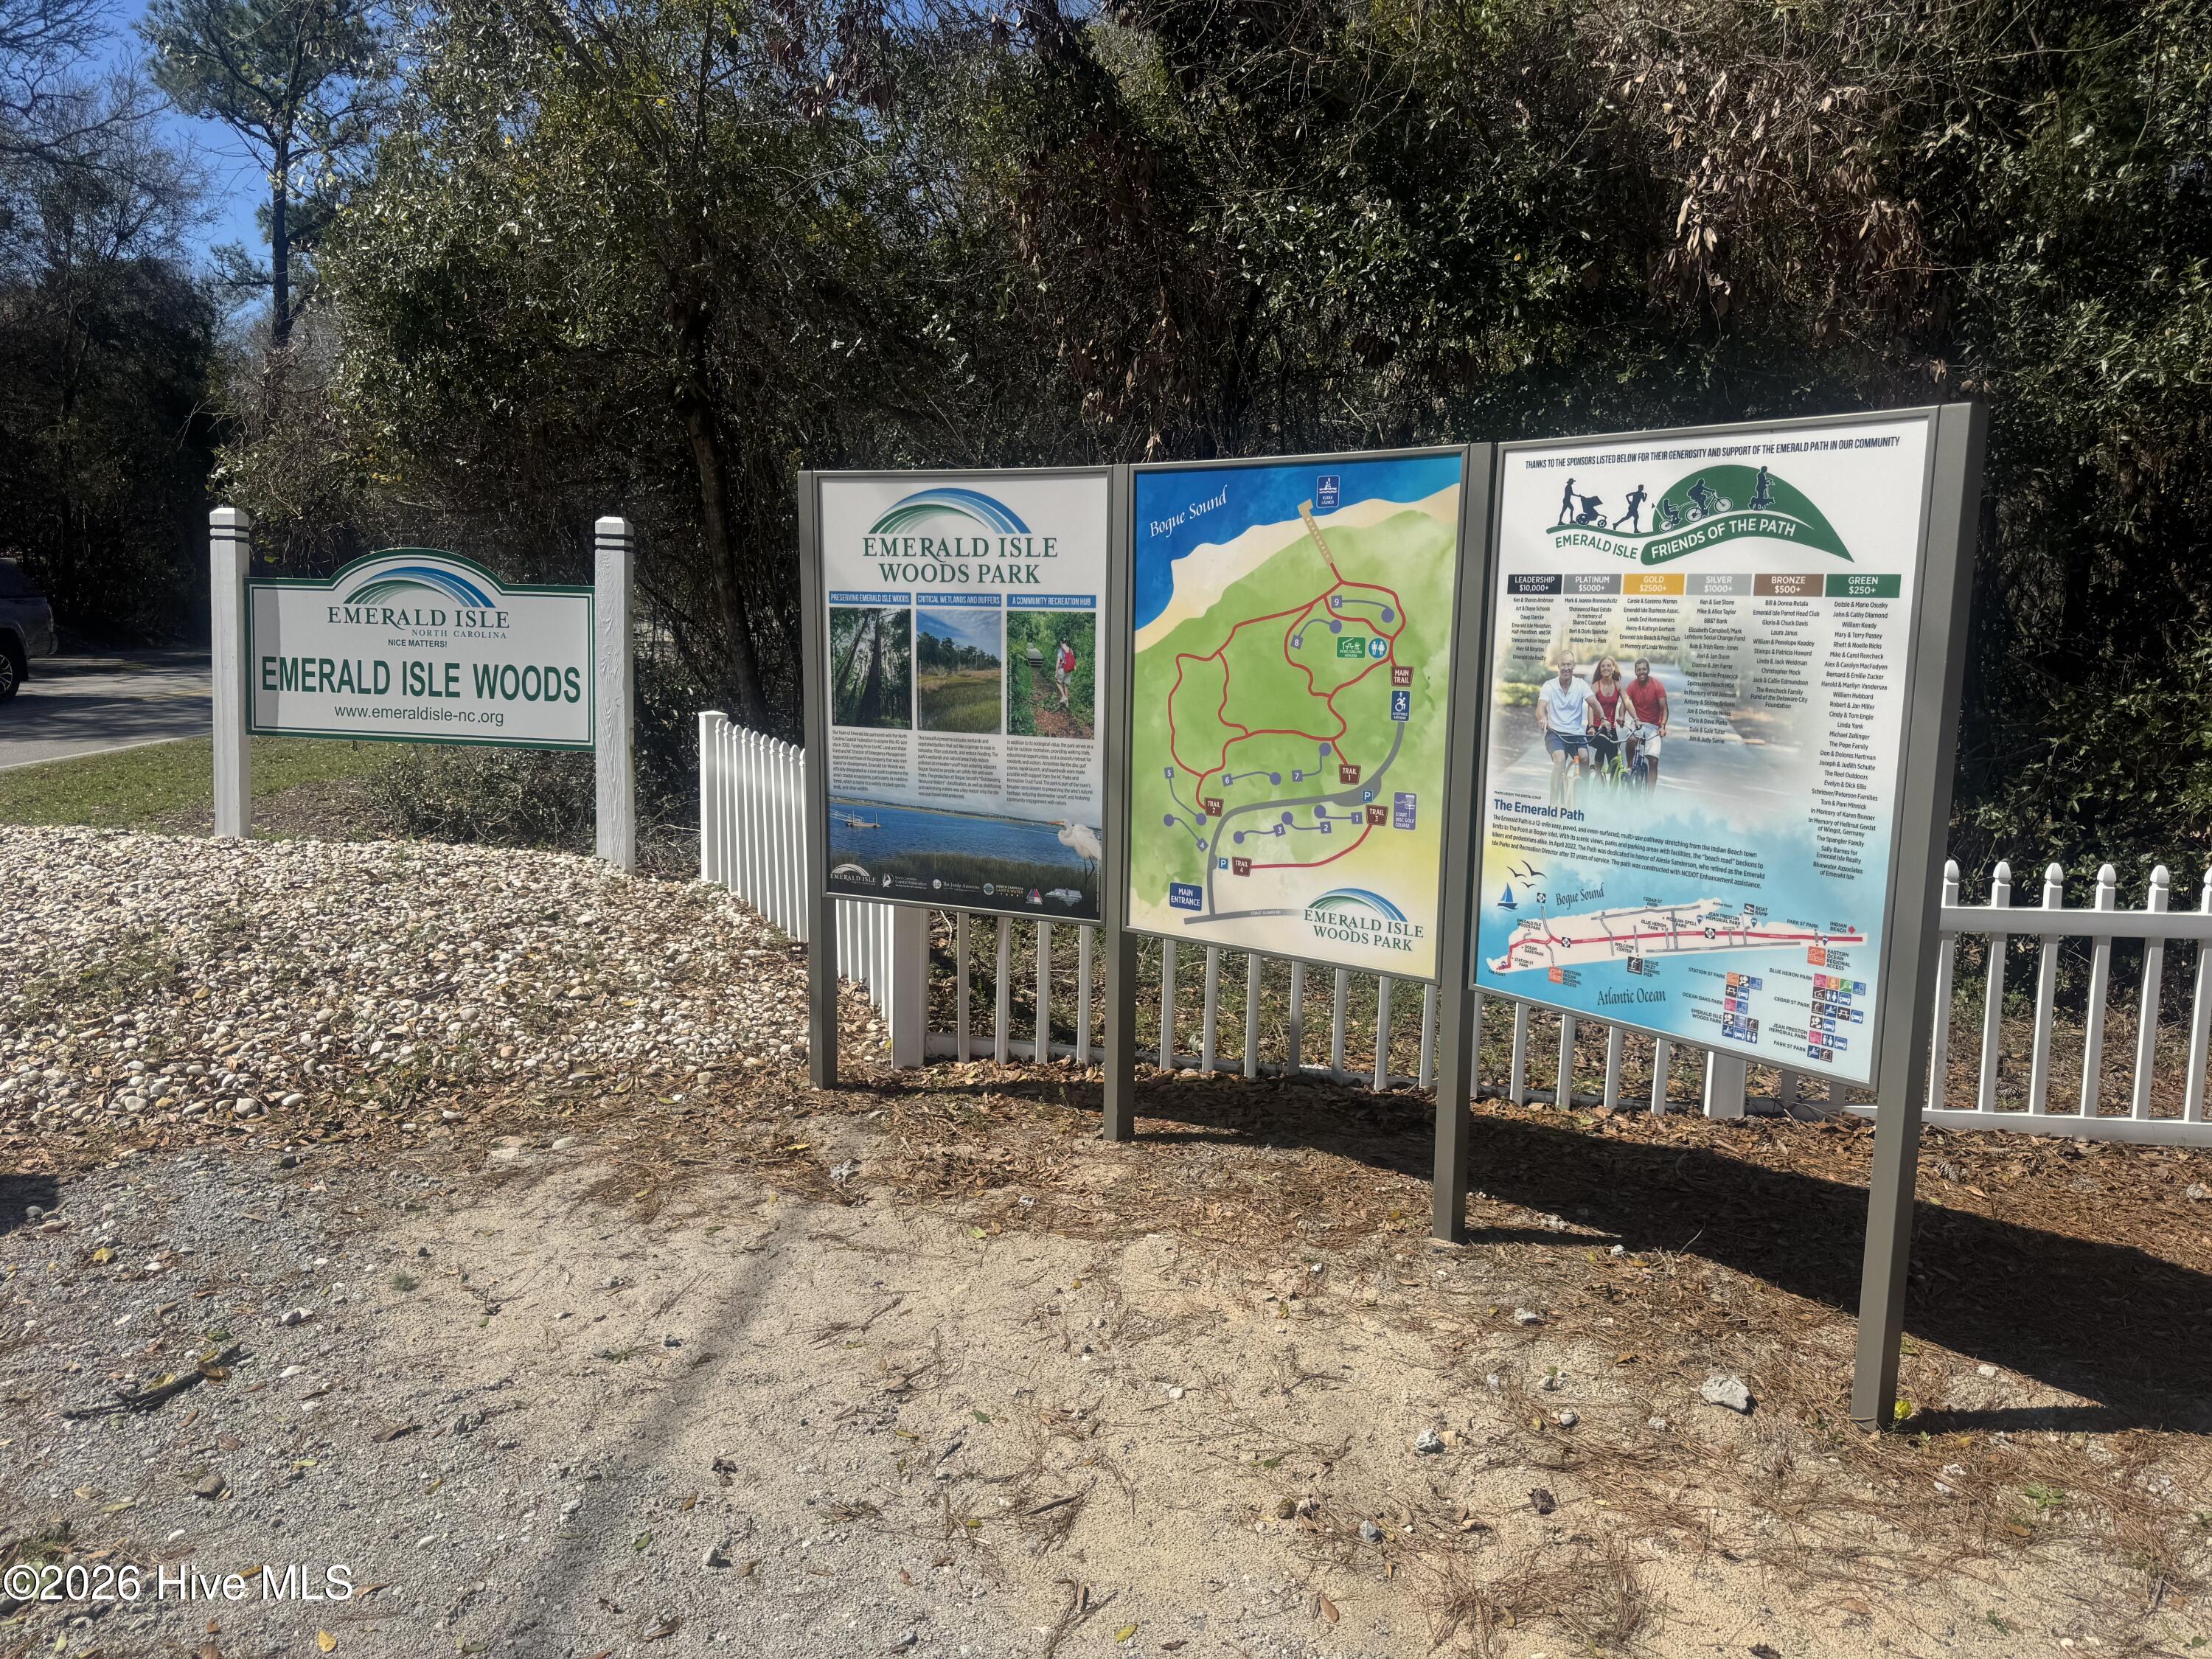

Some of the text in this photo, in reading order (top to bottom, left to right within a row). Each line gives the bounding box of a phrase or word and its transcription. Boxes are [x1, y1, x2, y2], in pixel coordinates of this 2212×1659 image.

[1526, 437, 1900, 469] THANKS TO THE SPONSORS LISTED BELOW FOR THEIR GENEROSITY AND SUPPORT OF THE EMERALD PATH IN OUR COMMUNITY
[1150, 484, 1228, 538] Bogue Sound
[1650, 518, 1795, 558] FRIENDS OF THE PATH
[863, 538, 1058, 562] EMERALD ISLE
[1555, 534, 1638, 559] EMERALD ISLE
[878, 563, 1041, 583] WOODS PARK
[1520, 584, 1548, 592] $10,000+
[1775, 585, 1801, 594] $500+
[1848, 586, 1876, 595] $250+
[1048, 597, 1079, 605] RECREATION
[327, 606, 509, 630] EMERALD ISLE
[412, 629, 507, 639] NORTH CAROLINA
[408, 639, 448, 648] MATTERS!
[262, 656, 581, 703] EMERALD ISLE WOODS
[335, 706, 504, 727] www.emeraldisle-nc.org
[1495, 799, 1585, 821] The Emerald Path
[830, 874, 861, 883] EMERALD
[1178, 888, 1193, 896] MAIN
[1556, 883, 1604, 910] Bogue Sound
[1171, 896, 1200, 906] ENTRANCE
[1304, 909, 1424, 938] EMERALD ISLE
[1313, 925, 1412, 951] WOODS PARK
[1827, 949, 1849, 957] EASTERN
[1826, 959, 1851, 967] REGIONAL
[1598, 987, 1666, 1006] Atlantic Ocean
[1691, 1009, 1712, 1017] EMERALD
[1769, 1027, 1793, 1037] MEMORIAL
[1786, 1026, 1807, 1034] PRESTON
